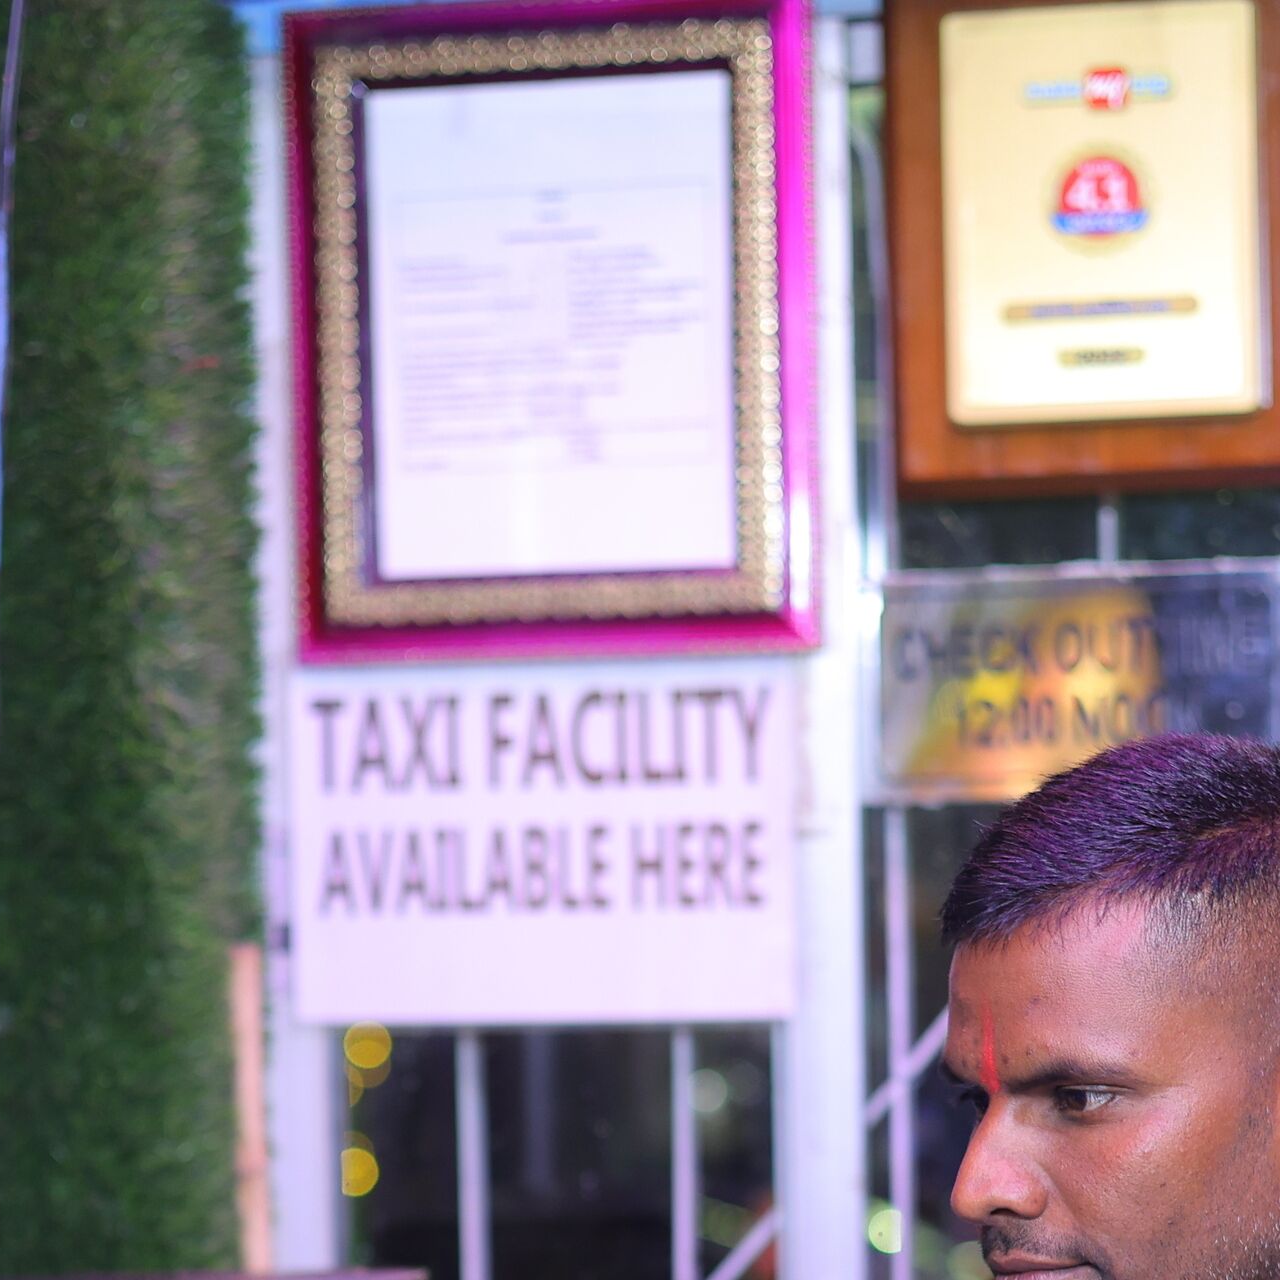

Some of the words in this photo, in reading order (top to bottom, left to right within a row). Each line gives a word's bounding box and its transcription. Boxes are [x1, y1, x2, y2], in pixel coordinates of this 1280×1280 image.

[894, 622, 1038, 682] CHECK
[1053, 614, 1157, 674] OUT
[310, 694, 460, 790] TAXI
[486, 685, 771, 787] FACILITY
[320, 822, 613, 916] AVAILABLE
[629, 820, 766, 908] HERE
